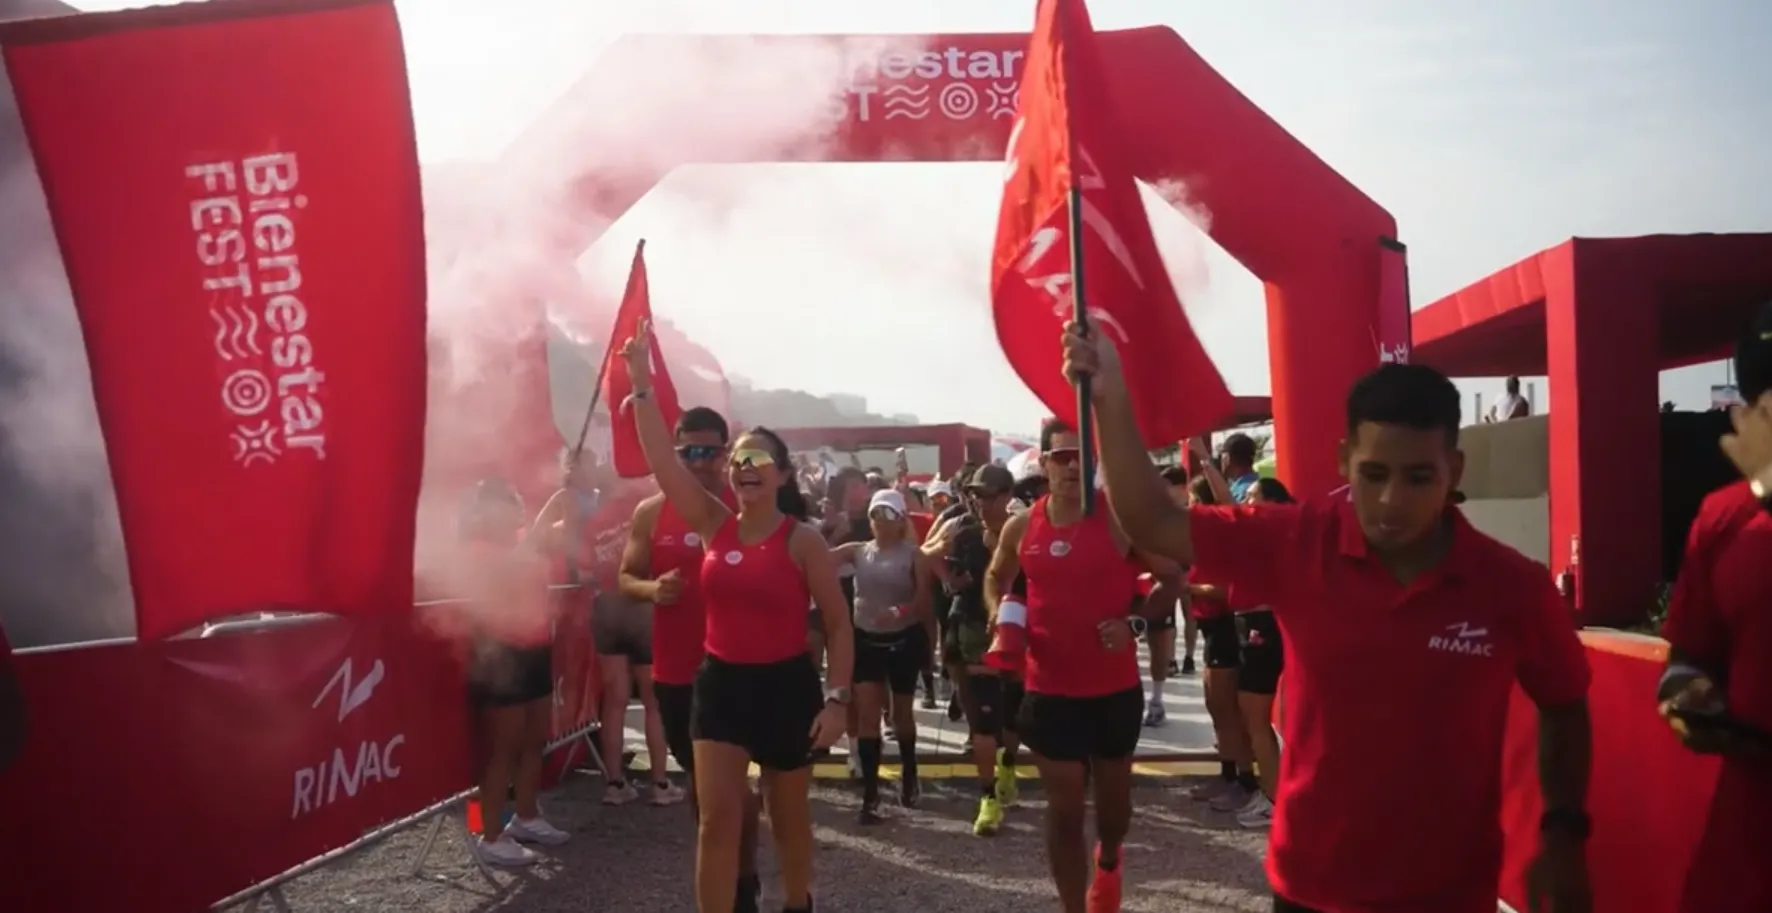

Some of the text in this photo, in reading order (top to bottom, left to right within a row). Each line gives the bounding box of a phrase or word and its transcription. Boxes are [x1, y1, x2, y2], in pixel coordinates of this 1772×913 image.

[848, 46, 1023, 79] nestar
[184, 160, 253, 298] FEST
[242, 152, 327, 461] Bienestar
[1428, 635, 1494, 658] RIMAC
